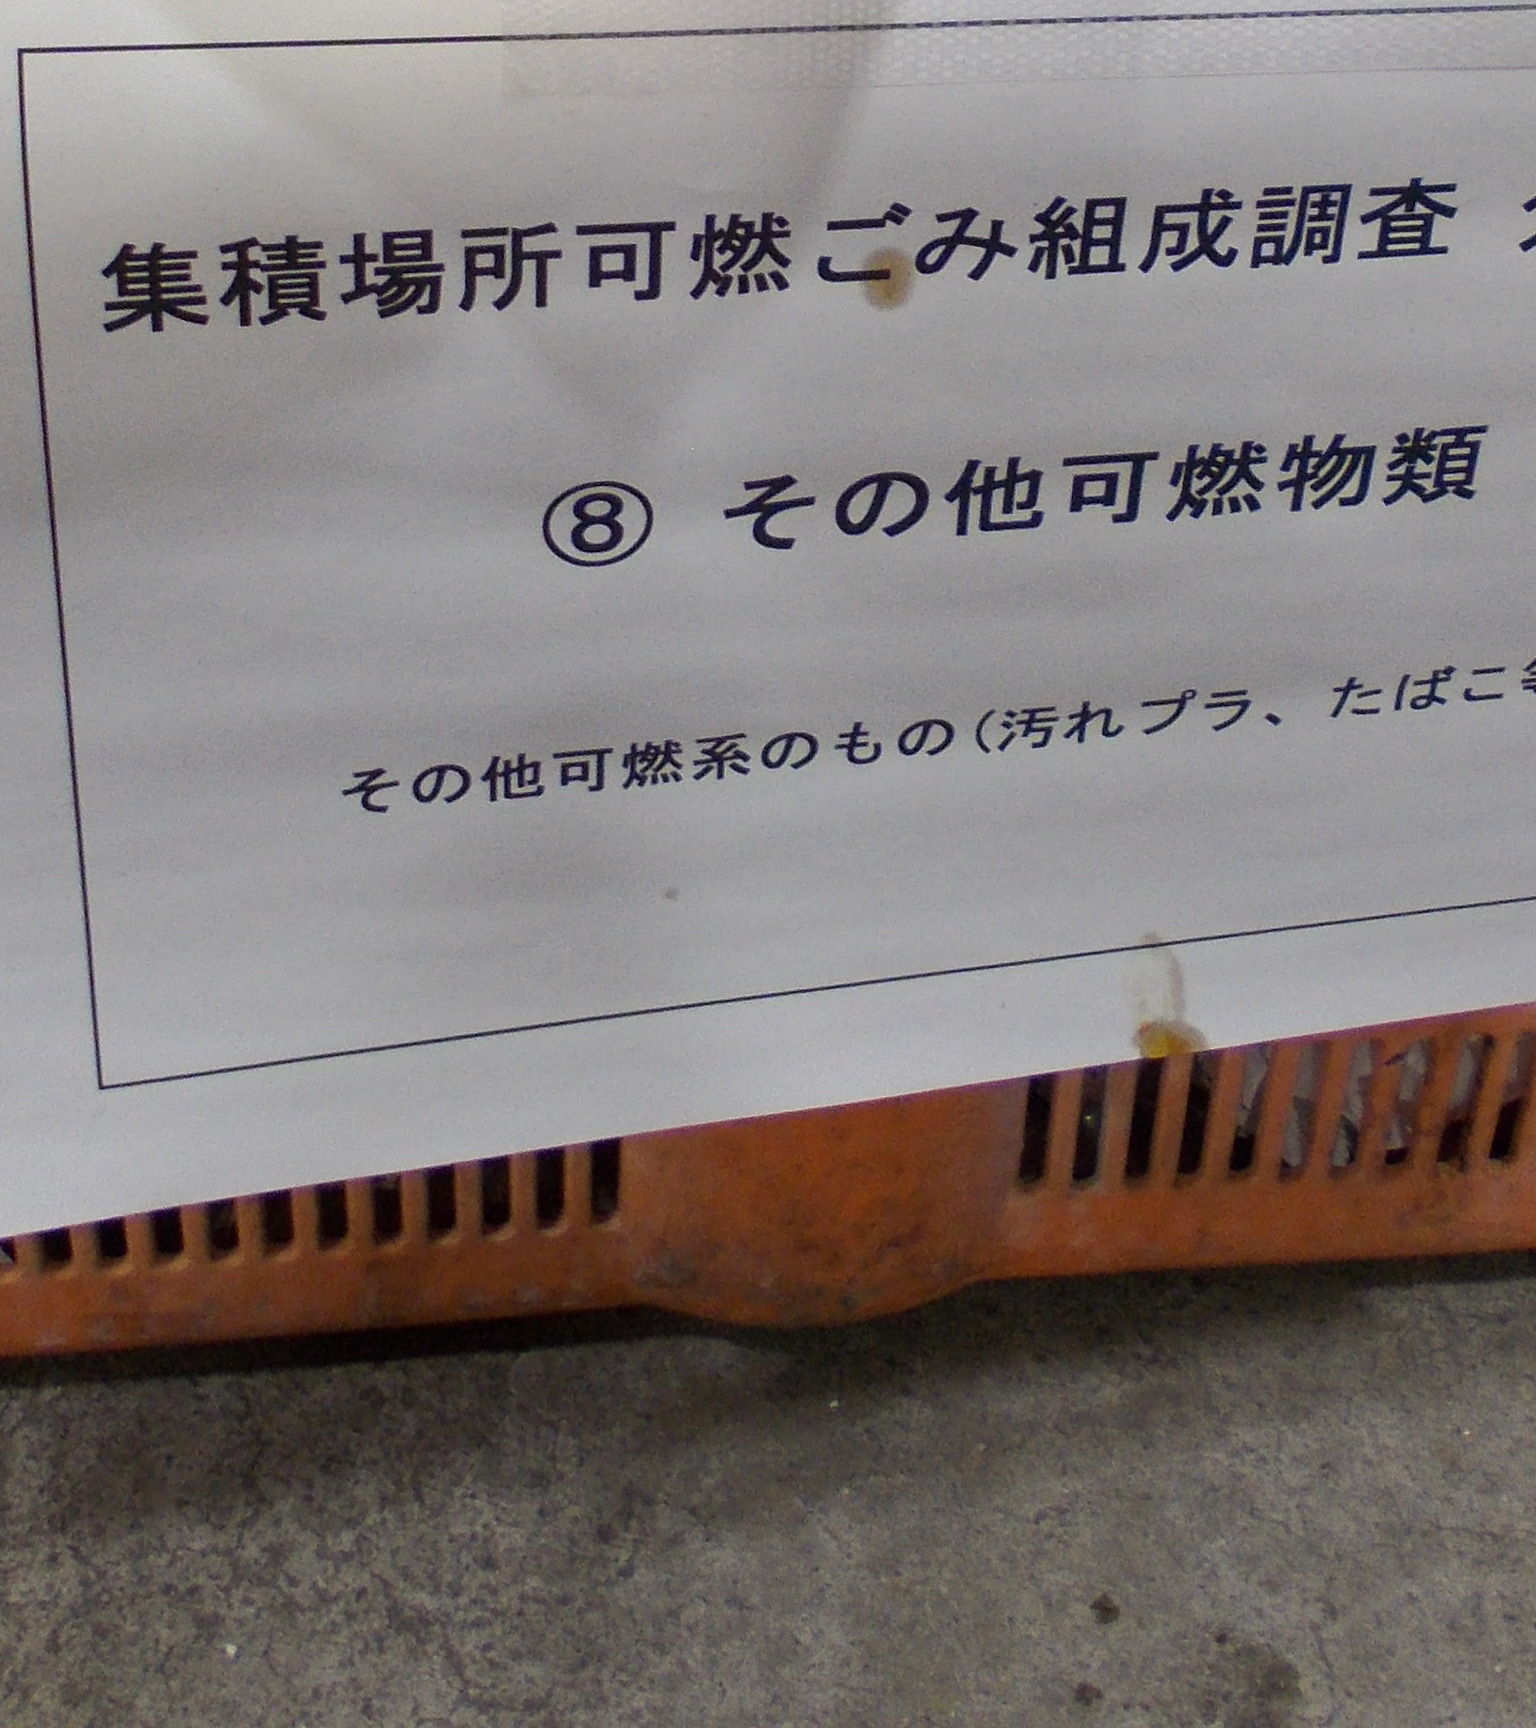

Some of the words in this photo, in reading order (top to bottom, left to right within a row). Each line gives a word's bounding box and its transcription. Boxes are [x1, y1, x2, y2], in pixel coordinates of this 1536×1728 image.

[100, 176, 1461, 334] 集積場所可燃ごみ組成調査
[721, 423, 1491, 551] その他可燃物類
